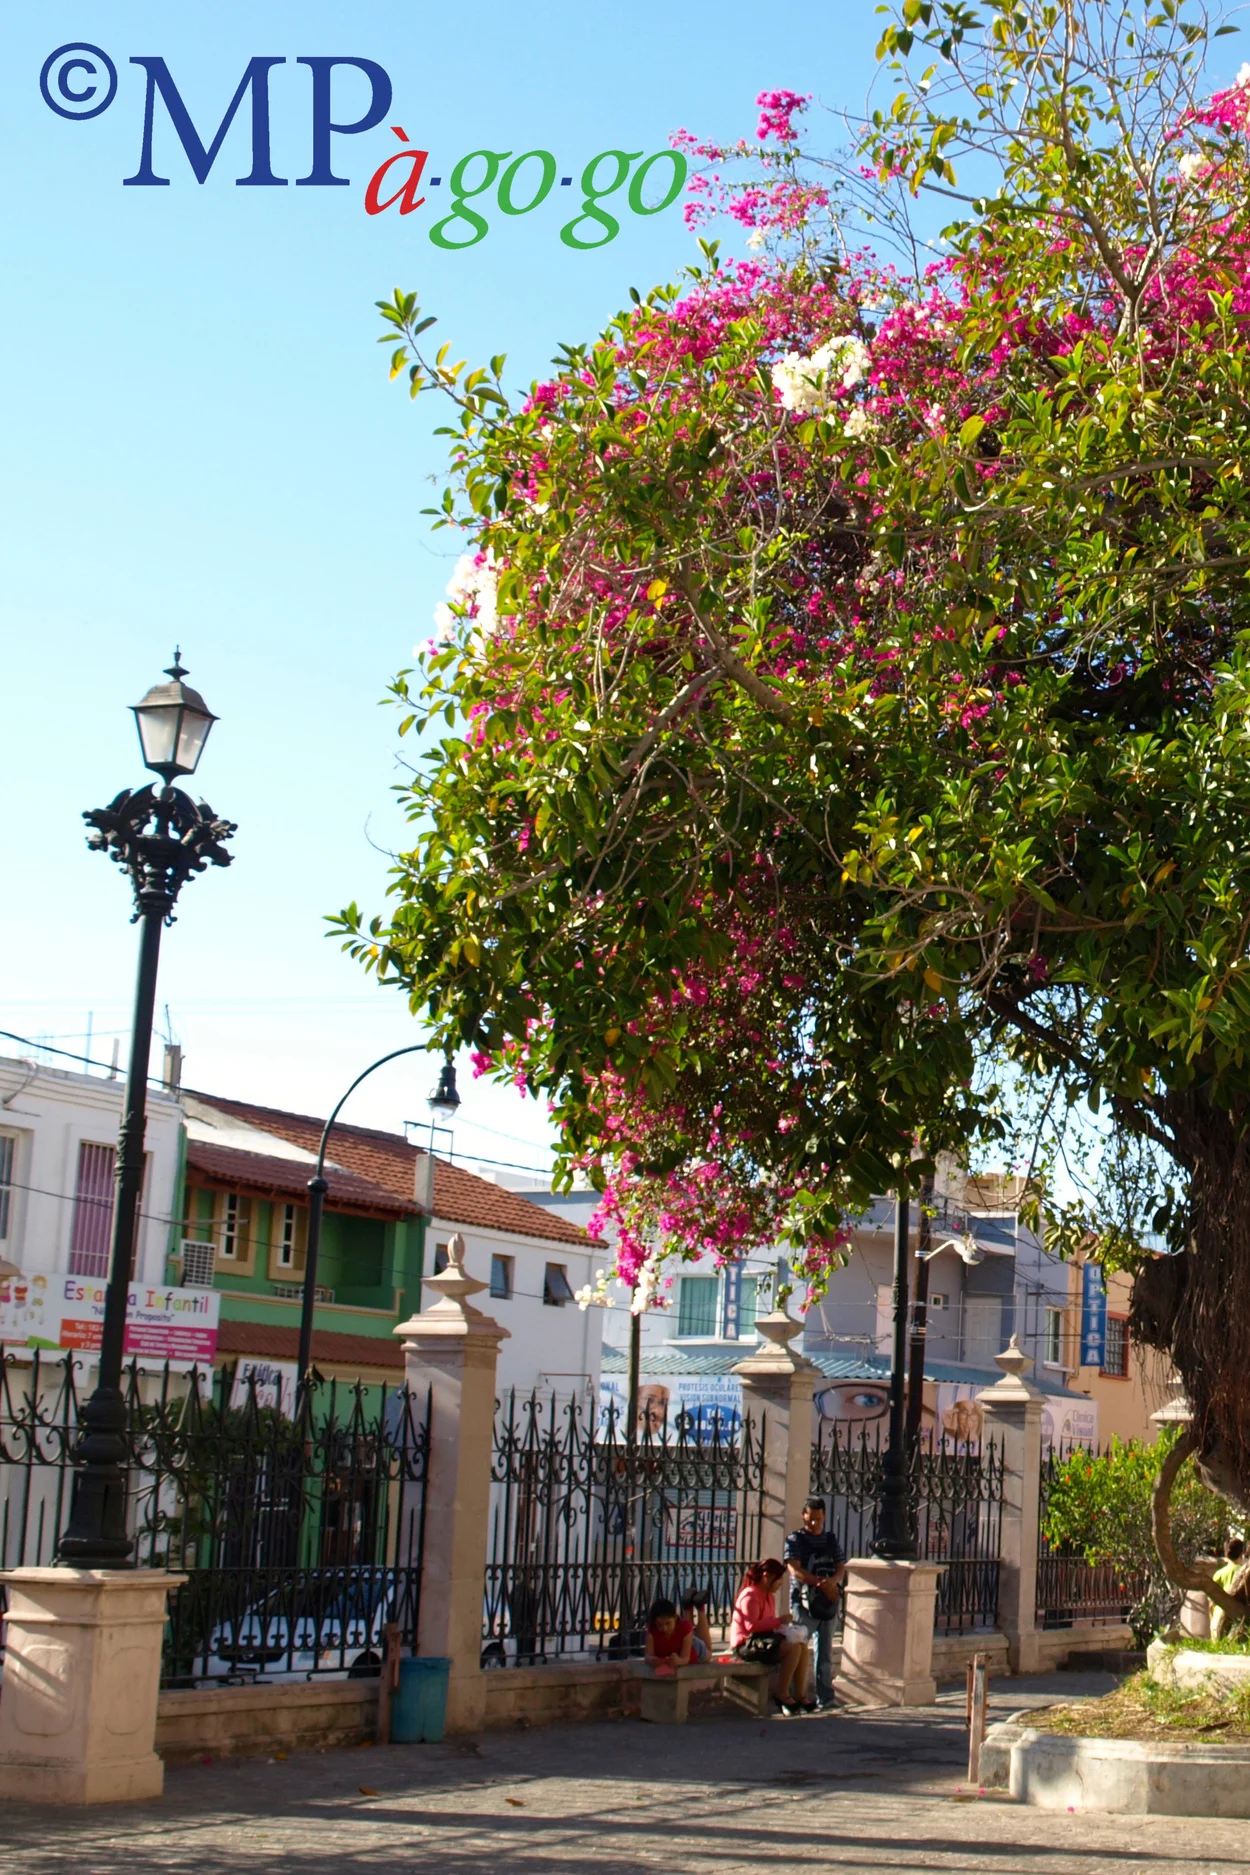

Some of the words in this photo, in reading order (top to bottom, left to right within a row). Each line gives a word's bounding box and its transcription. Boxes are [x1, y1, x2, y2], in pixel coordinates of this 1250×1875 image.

[64, 1280, 137, 1306] Estaa
[145, 1289, 210, 1314] Infantil
[725, 1265, 738, 1338] TICA
[1085, 1267, 1101, 1363] OPTICA
[679, 1383, 708, 1391] PROTESIS
[702, 1394, 740, 1402] SUBNORMAL
